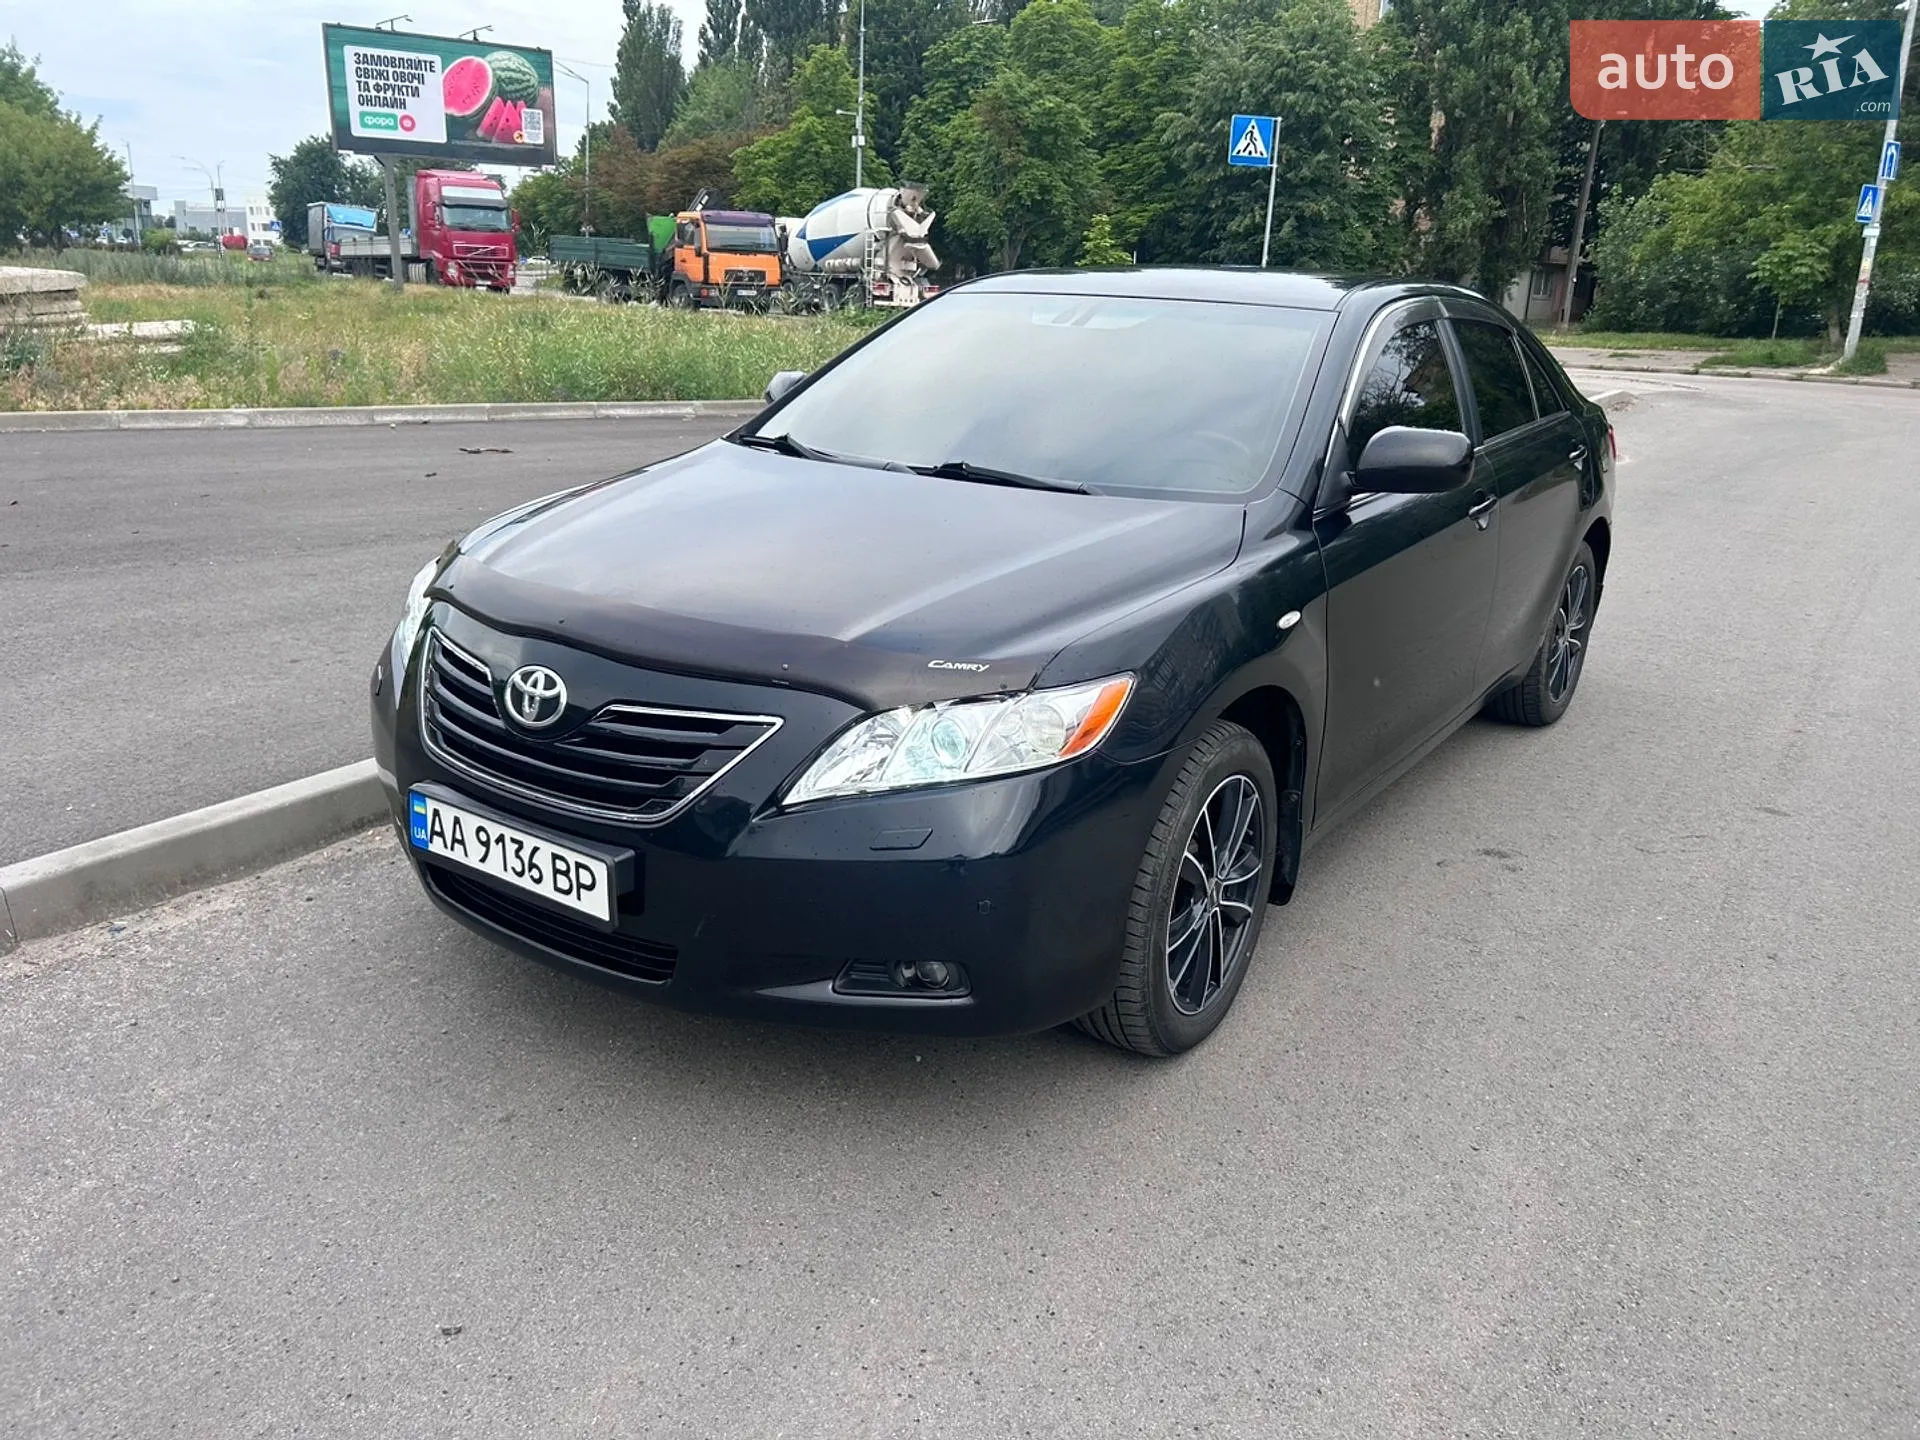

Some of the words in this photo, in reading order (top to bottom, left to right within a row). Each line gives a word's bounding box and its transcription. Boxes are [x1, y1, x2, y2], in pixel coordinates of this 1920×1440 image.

[354, 52, 436, 73] ЗАМОВЛЯЙТЕ
[355, 67, 390, 82] СВІЖІ
[392, 70, 425, 85] ОВОЧІ
[356, 80, 371, 93] ТА
[373, 82, 420, 98] ФРУКТИ
[927, 660, 990, 672] CAMRY
[414, 827, 427, 841] UA
[429, 808, 469, 857] AA
[475, 825, 544, 885] 9136
[551, 852, 597, 901] BP
